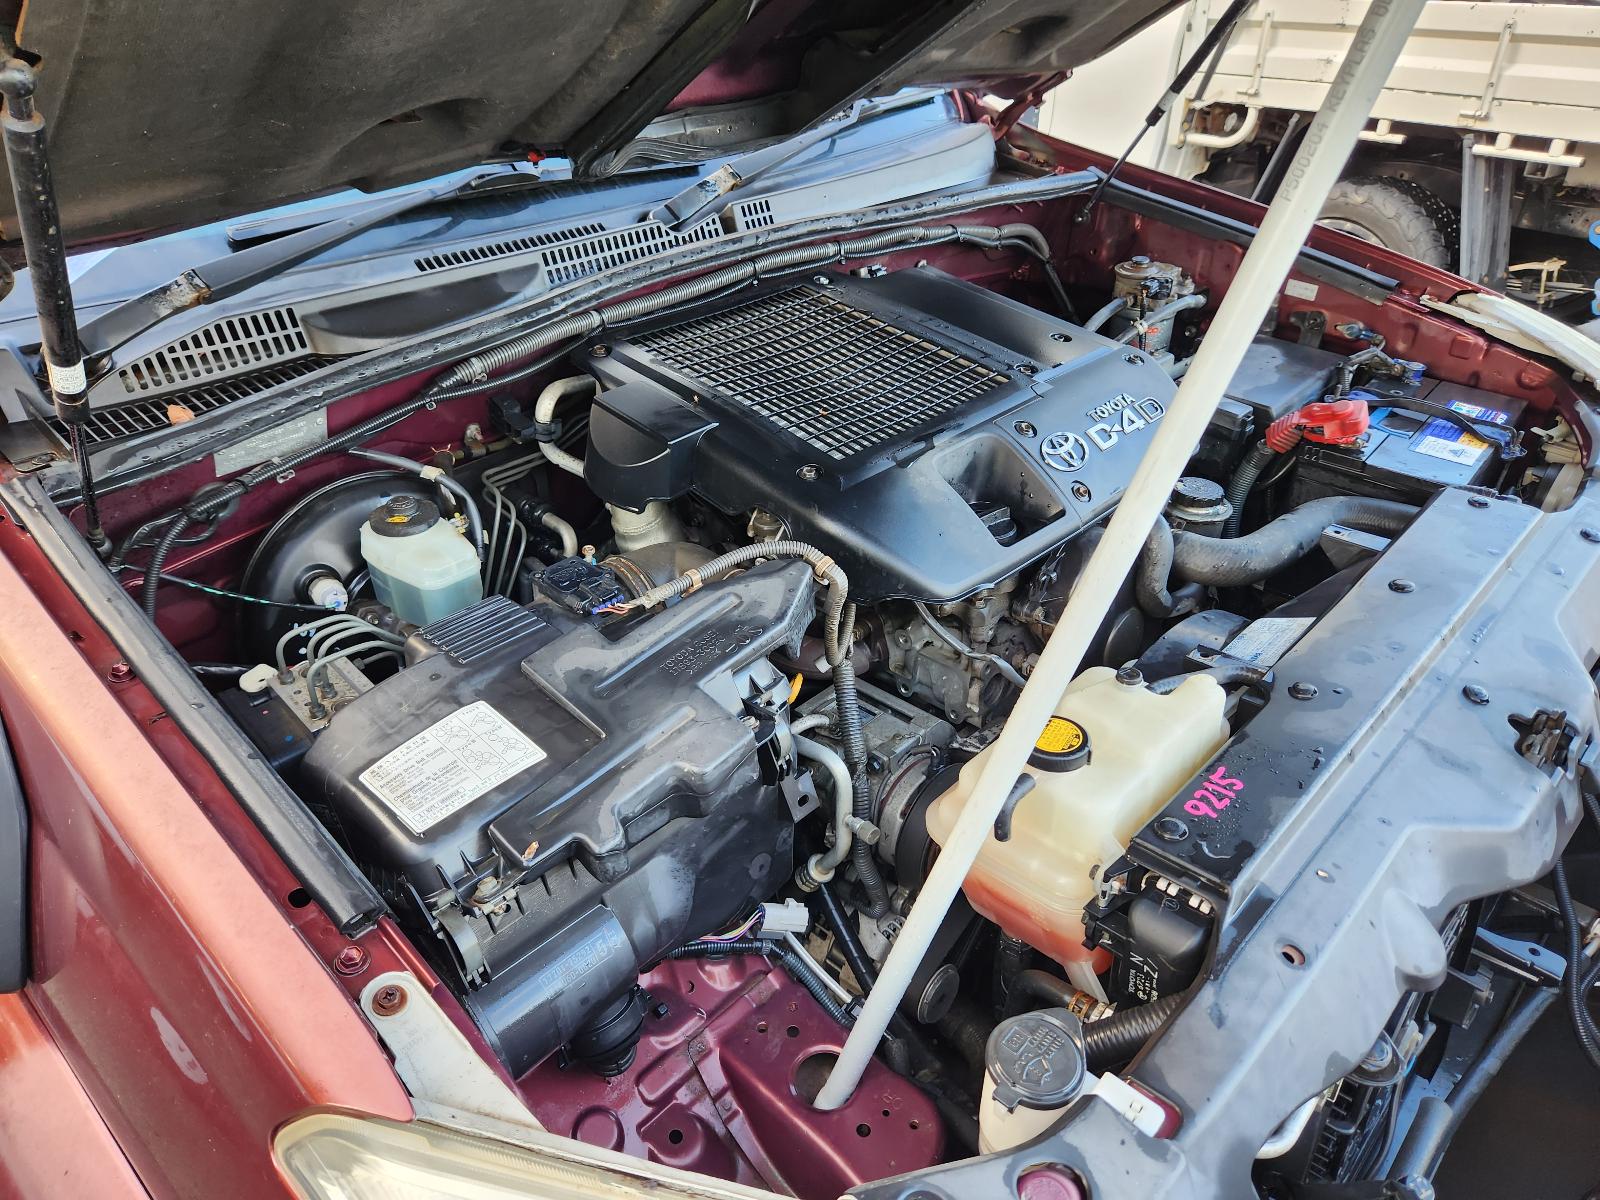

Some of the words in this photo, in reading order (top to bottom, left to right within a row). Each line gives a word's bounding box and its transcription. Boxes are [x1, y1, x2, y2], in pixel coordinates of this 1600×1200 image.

[1087, 393, 1136, 422] TOYOTA
[1183, 766, 1244, 818] 9215
[1128, 969, 1136, 993] TOYOTA
